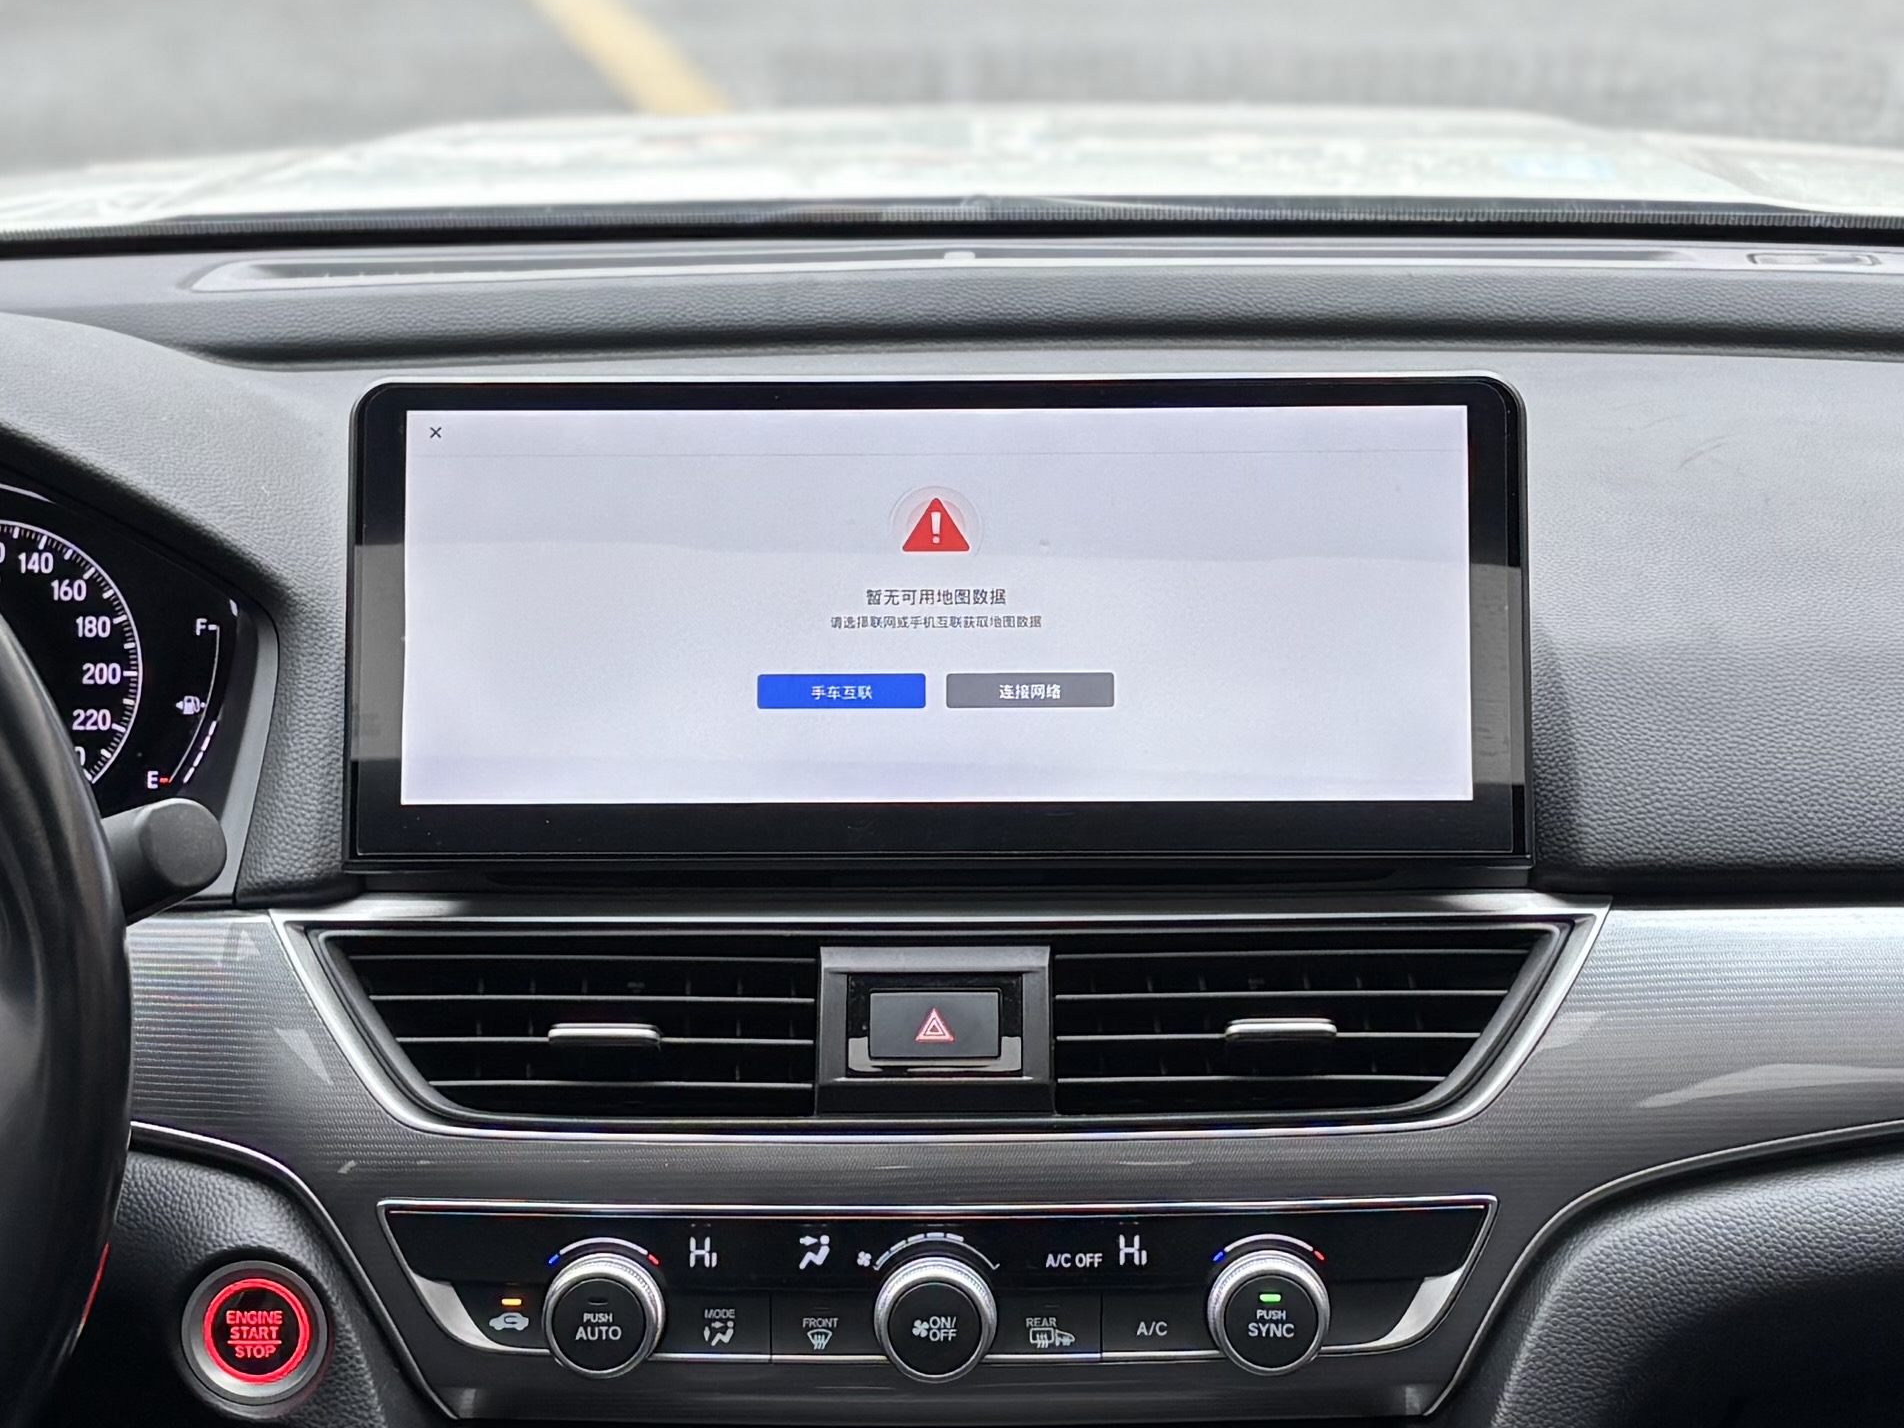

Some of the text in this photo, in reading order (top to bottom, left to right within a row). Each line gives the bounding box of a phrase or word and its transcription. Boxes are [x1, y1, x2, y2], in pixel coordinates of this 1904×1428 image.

[18, 551, 55, 574] 140
[51, 579, 87, 603] 160
[865, 589, 1007, 606] 暂无可用地图数据
[76, 615, 111, 638] 180
[195, 618, 207, 636] F
[82, 662, 121, 685] 200
[810, 685, 874, 701] 手车互联
[998, 683, 1062, 701] 连接网络
[71, 708, 111, 731] 220
[147, 771, 159, 789] E
[1045, 1252, 1103, 1270] A/C OFF
[226, 1310, 283, 1325] ENGINE
[583, 1312, 613, 1323] PUSH
[703, 1308, 736, 1319] MODE
[1256, 1309, 1287, 1321] PUSH
[802, 1317, 839, 1328] FRONT
[929, 1315, 957, 1331] ON/
[1026, 1317, 1057, 1328] REAR
[1136, 1320, 1168, 1337] A/C
[230, 1326, 279, 1340] START
[575, 1326, 622, 1341] AUTO
[929, 1328, 957, 1342] OFF
[1248, 1323, 1295, 1339] SYNC
[235, 1345, 277, 1359] STOP
